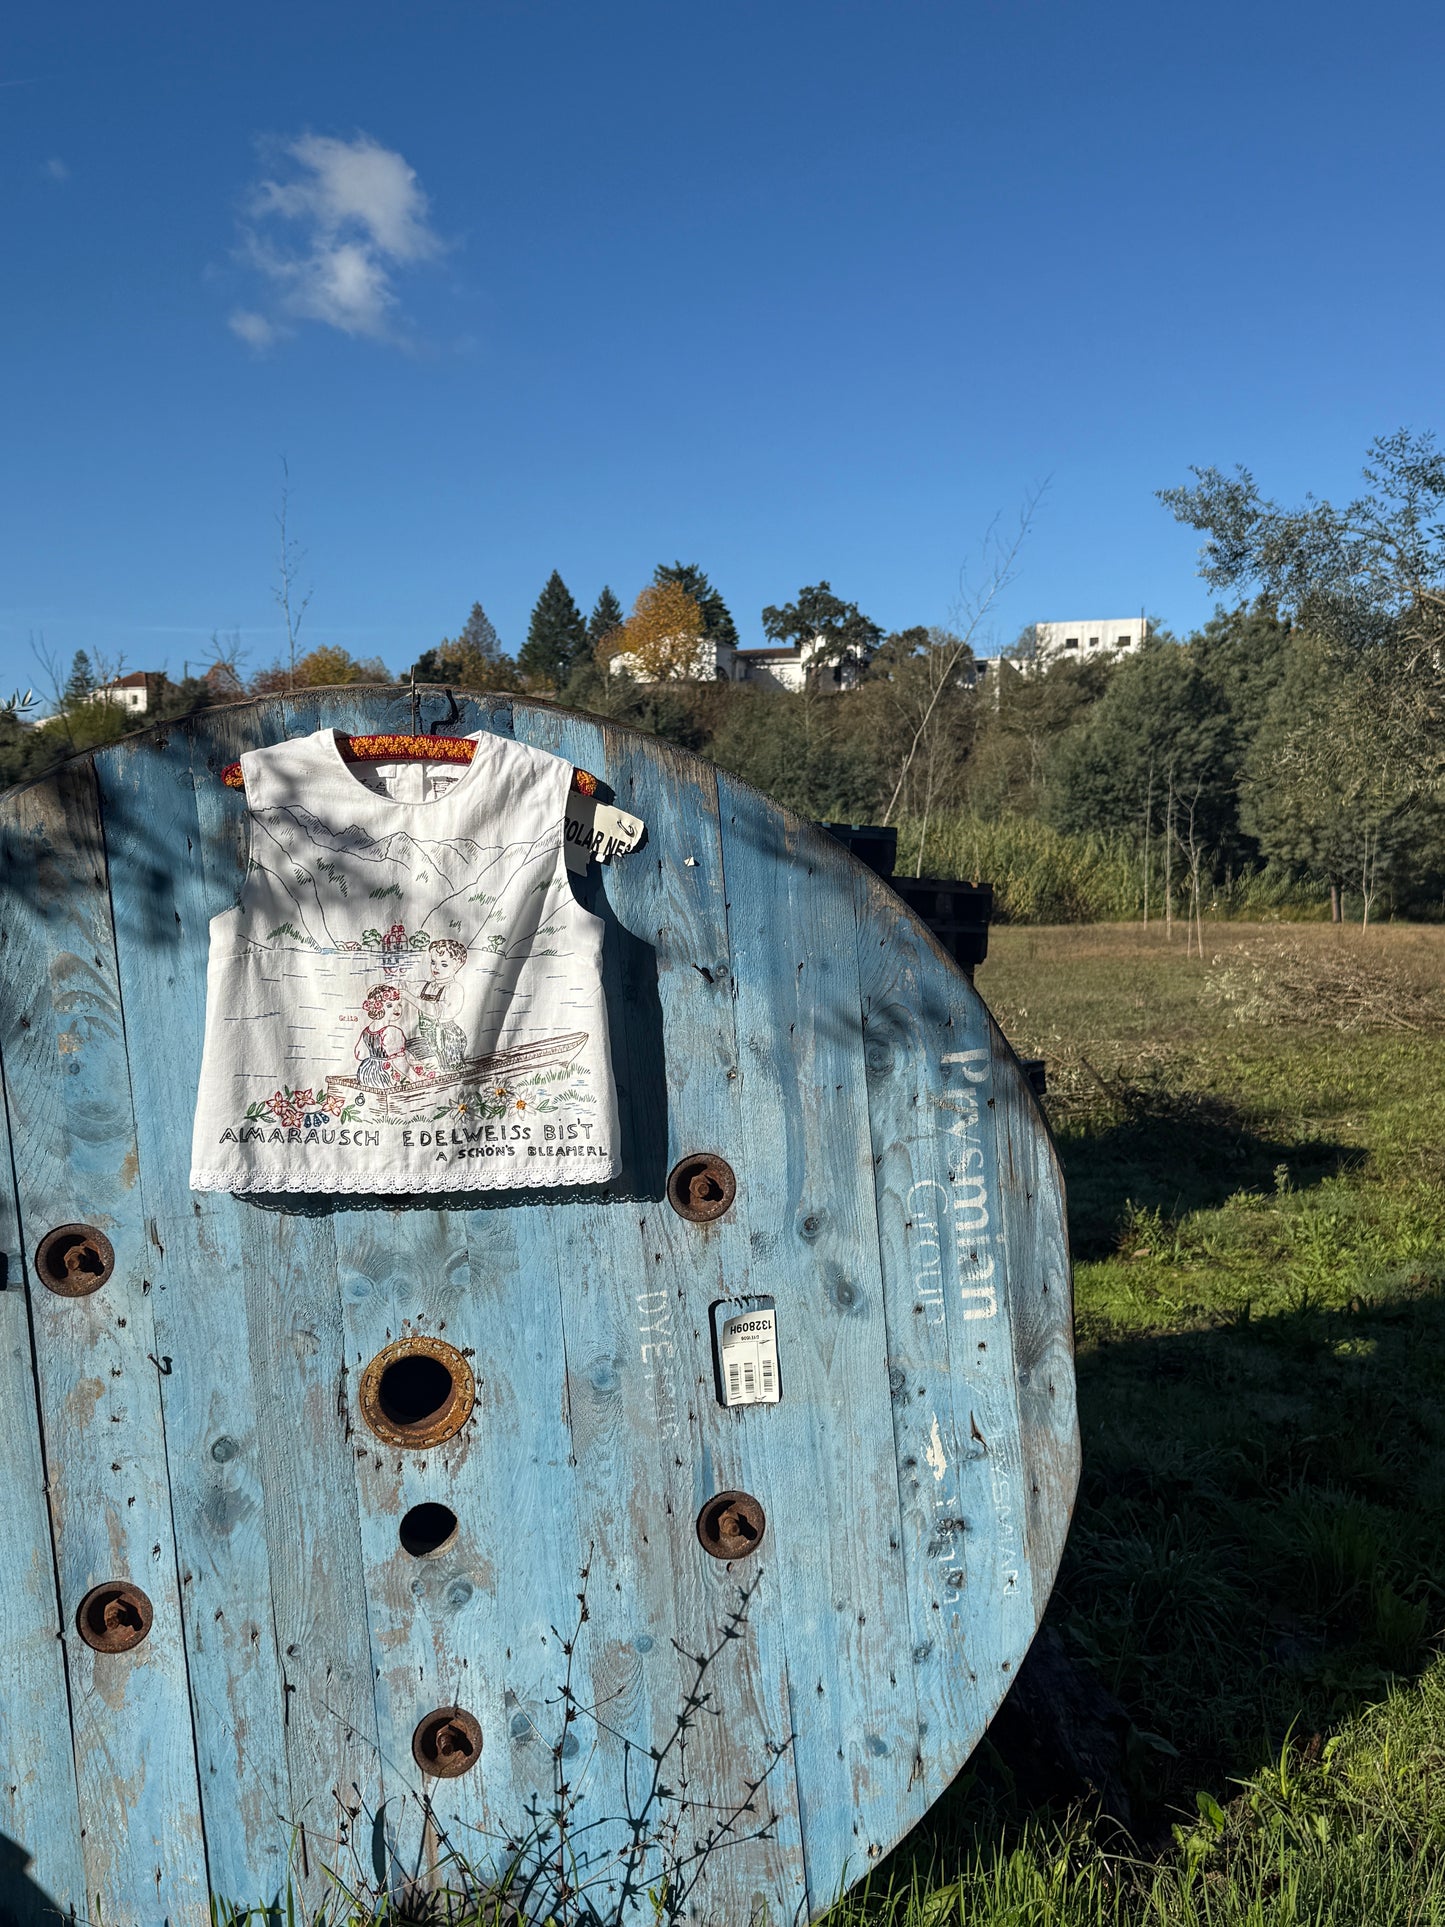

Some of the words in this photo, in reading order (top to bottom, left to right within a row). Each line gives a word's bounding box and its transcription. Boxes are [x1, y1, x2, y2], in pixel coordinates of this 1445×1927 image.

[219, 1127, 380, 1147] ALMARAUSCH
[436, 1152, 448, 1162] A
[937, 1049, 1004, 1320] Prysmian
[730, 1320, 772, 1334] 132809H
